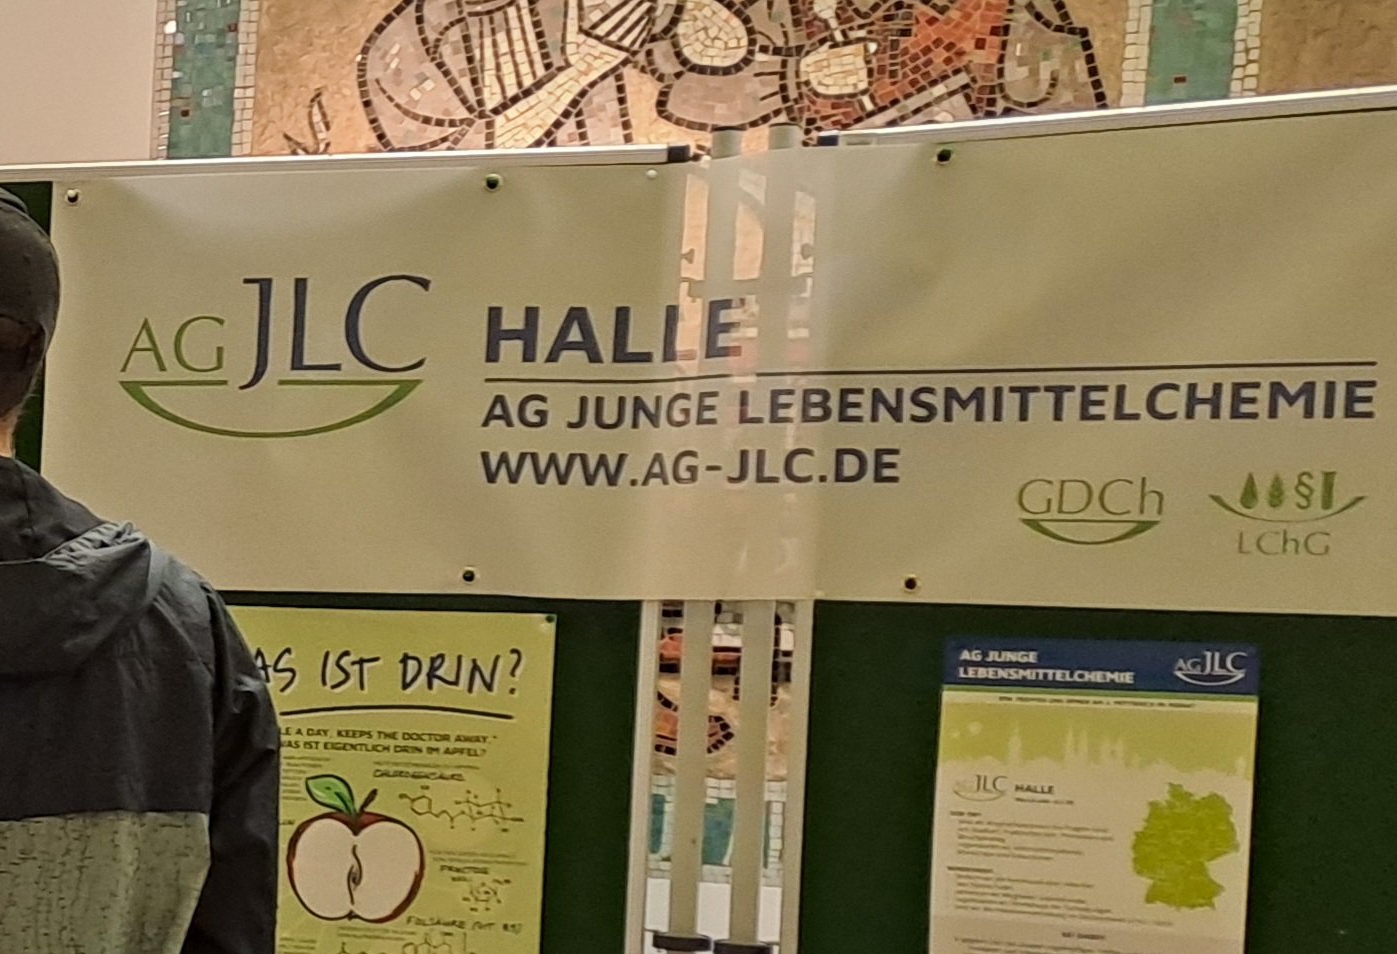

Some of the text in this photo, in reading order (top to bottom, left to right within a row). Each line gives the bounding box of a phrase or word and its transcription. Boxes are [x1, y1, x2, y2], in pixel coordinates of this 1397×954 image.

[120, 274, 432, 390] AG JLC
[484, 298, 746, 364] HALLE
[481, 379, 1378, 430] AG JUNGE LEBENSMITTELCHEMIE
[480, 446, 901, 487] WWW.AG-JLC.DE
[1016, 476, 1165, 517] GDCh
[1237, 528, 1331, 557] LChG
[254, 646, 297, 693] AS
[320, 649, 381, 692] IST
[959, 649, 1039, 664] AG JUNGE
[1174, 650, 1249, 676] AG JLC
[958, 667, 1135, 684] LEBENSMITTELCHEMIE
[336, 729, 373, 739] KEEPS
[377, 730, 398, 740] THE
[402, 731, 451, 742] DOCTOR
[1014, 783, 1055, 795] HALLE
